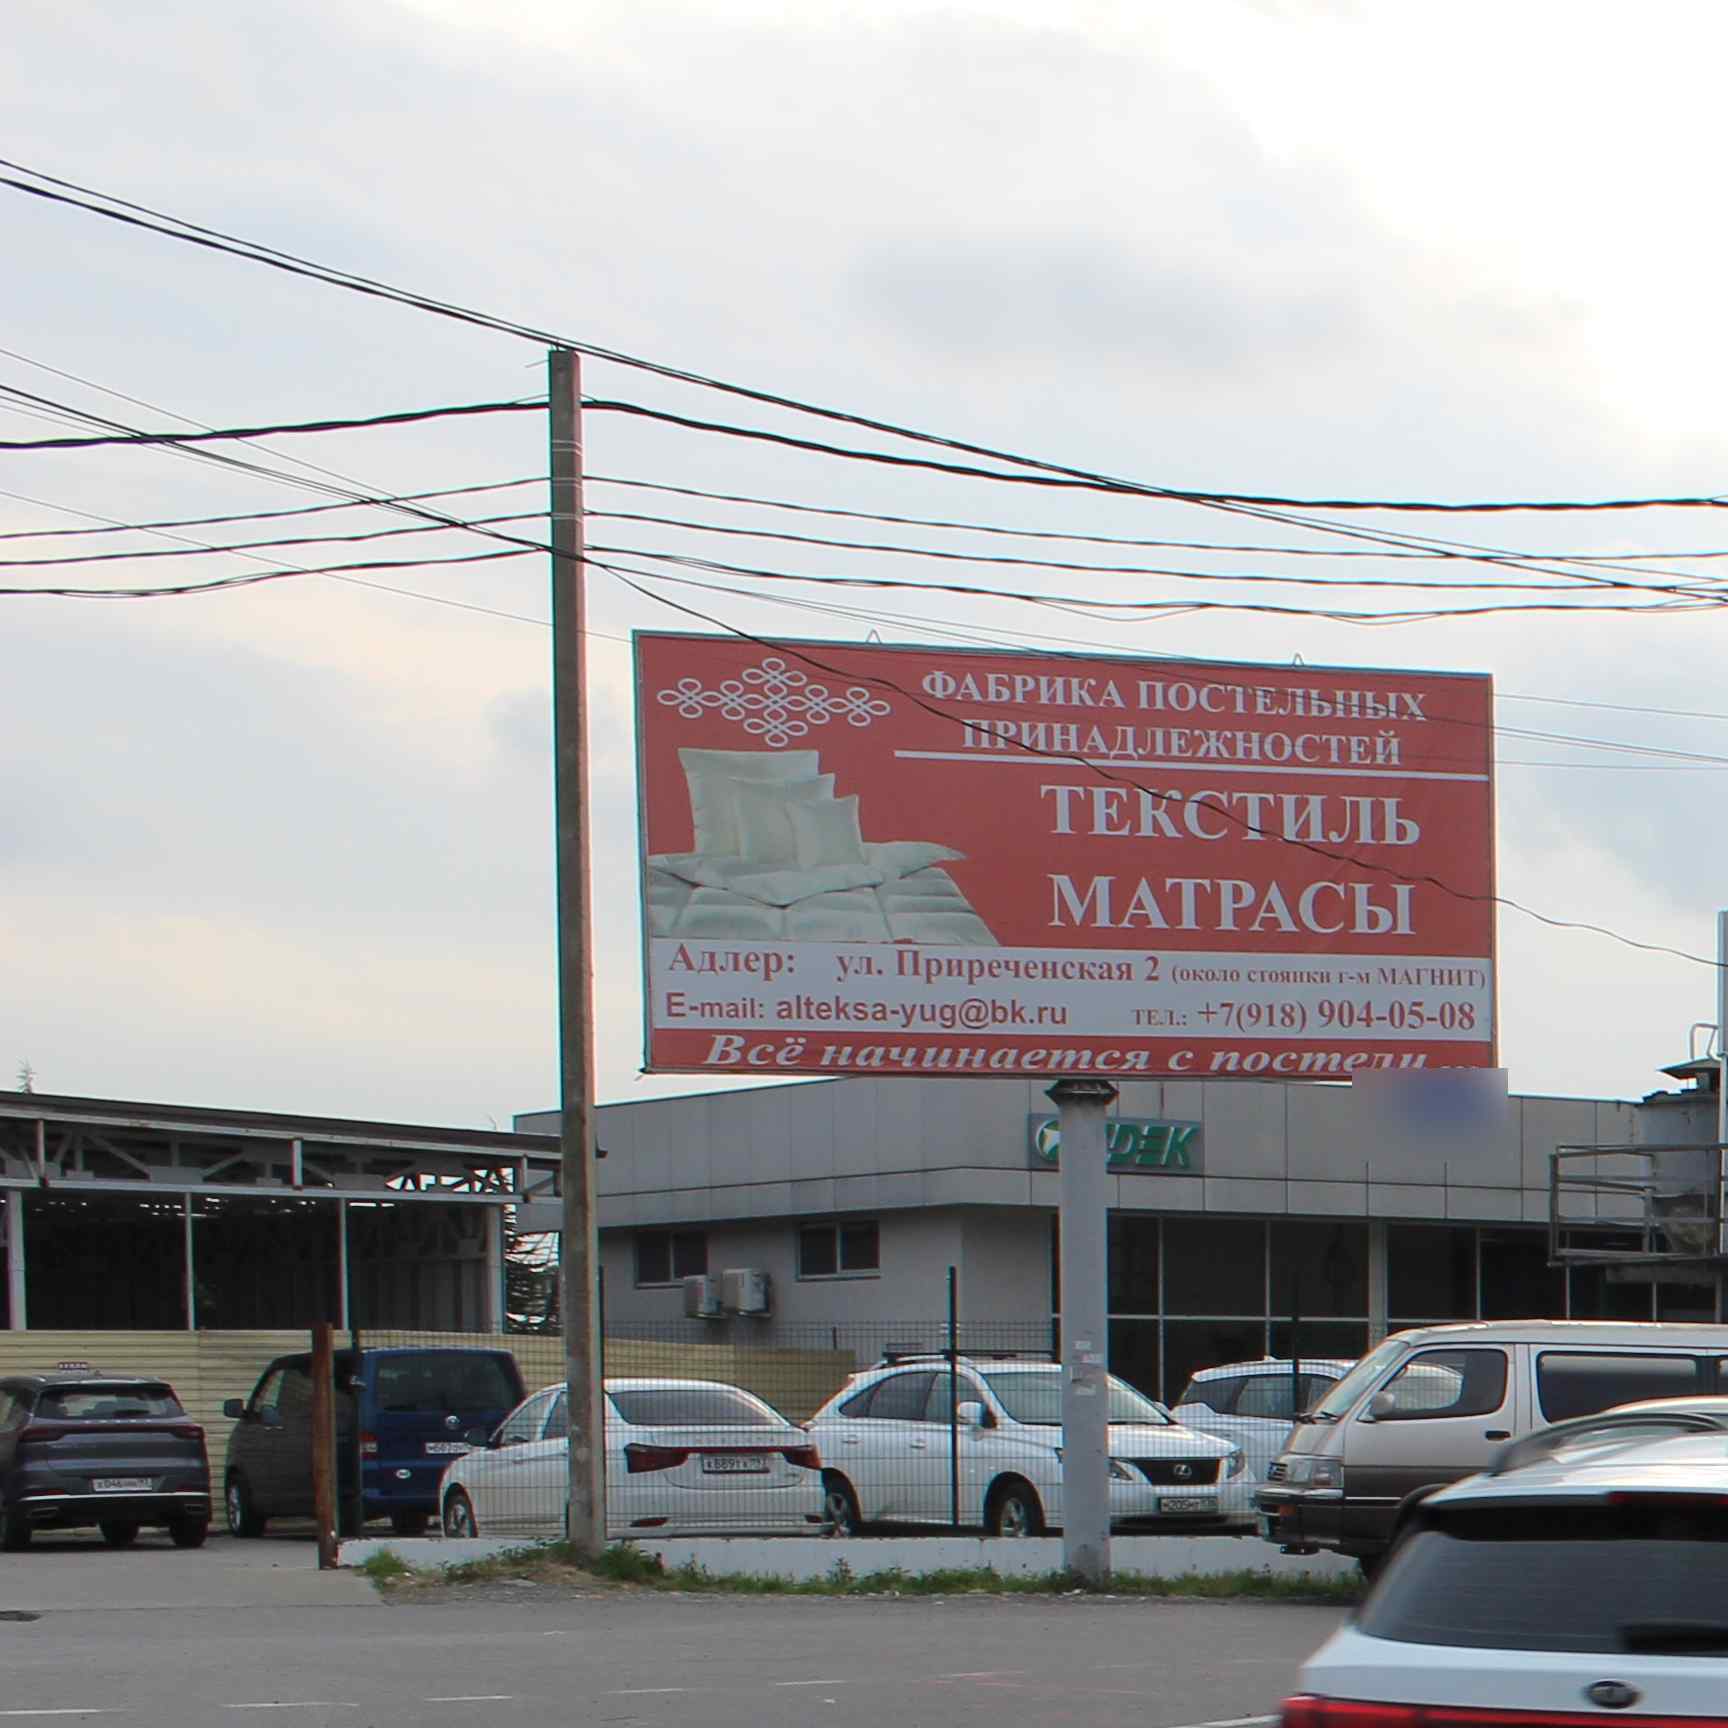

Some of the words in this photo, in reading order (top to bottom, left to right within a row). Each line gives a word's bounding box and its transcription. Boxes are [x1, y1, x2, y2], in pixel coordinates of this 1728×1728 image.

[921, 669, 1126, 710] ФАБРИКА
[1137, 679, 1427, 722] ПОСТЕЛЬНЫХ
[962, 718, 1402, 766] ПРИНАДЛЕЖНОСТЕЙ
[1040, 783, 1421, 846] ТЕКСТИЛЬ
[1046, 872, 1417, 936] МАТРАСЫ
[668, 942, 796, 982] Адлер:
[836, 953, 884, 984] ул.
[895, 949, 1135, 987] Приреченская
[1143, 955, 1161, 983] 2
[1171, 966, 1241, 985] (около
[1247, 968, 1332, 986] стоянки
[1377, 966, 1487, 989] МАГНИТ)
[666, 991, 764, 1019] E-mail:
[776, 994, 1068, 1030] alteksa-yug@bk.ru
[1130, 1008, 1188, 1027] ТЕЛ.:
[1197, 1000, 1308, 1033] +7(918)
[1318, 999, 1476, 1031] 904-05-08
[702, 1033, 807, 1067] Всё
[819, 1042, 1151, 1071] начинается
[1168, 1050, 1204, 1071] с
